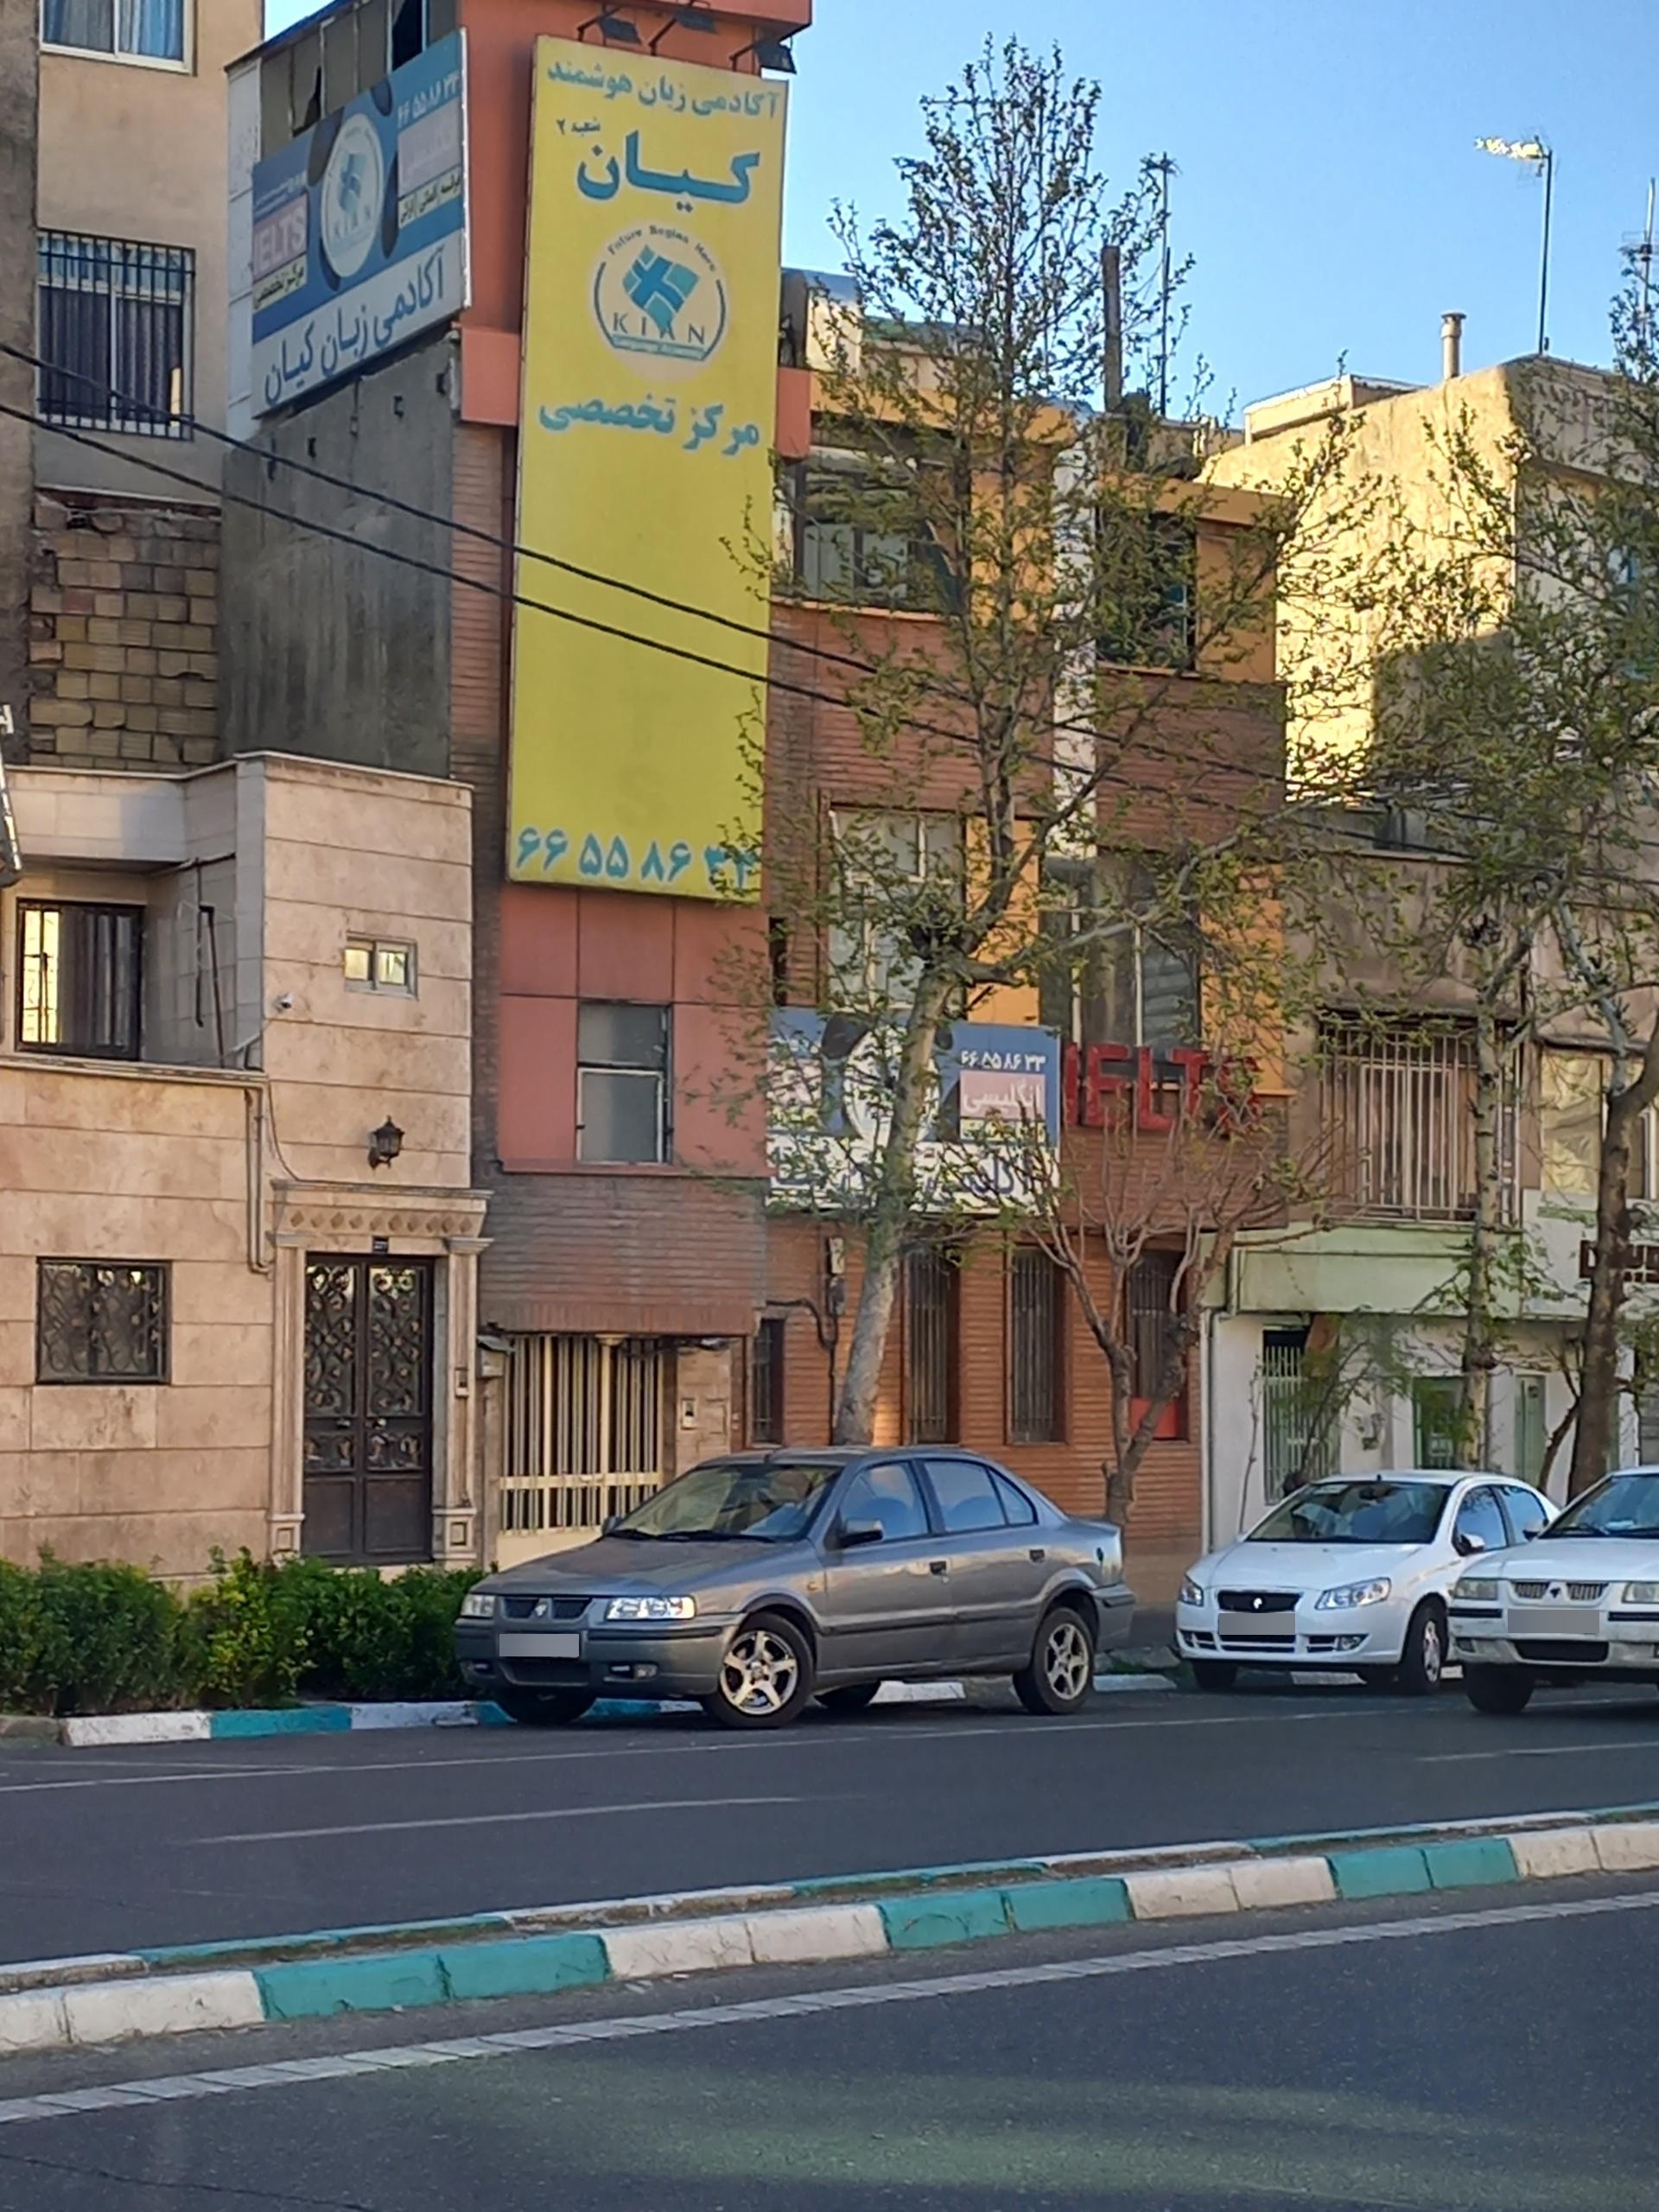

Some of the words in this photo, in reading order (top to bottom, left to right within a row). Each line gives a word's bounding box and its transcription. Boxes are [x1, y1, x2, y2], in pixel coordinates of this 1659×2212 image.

[547, 60, 633, 100] هوشمند
[639, 74, 686, 113] زبان
[692, 89, 779, 119] آکادمی
[576, 130, 761, 213] کیان
[252, 208, 305, 277] IELTS
[374, 245, 447, 345] آکادمی
[321, 304, 371, 378] زبان
[613, 311, 706, 346] KIAN
[264, 321, 315, 406] کیان
[538, 394, 676, 434] تخصصی
[682, 404, 760, 455] مرکز
